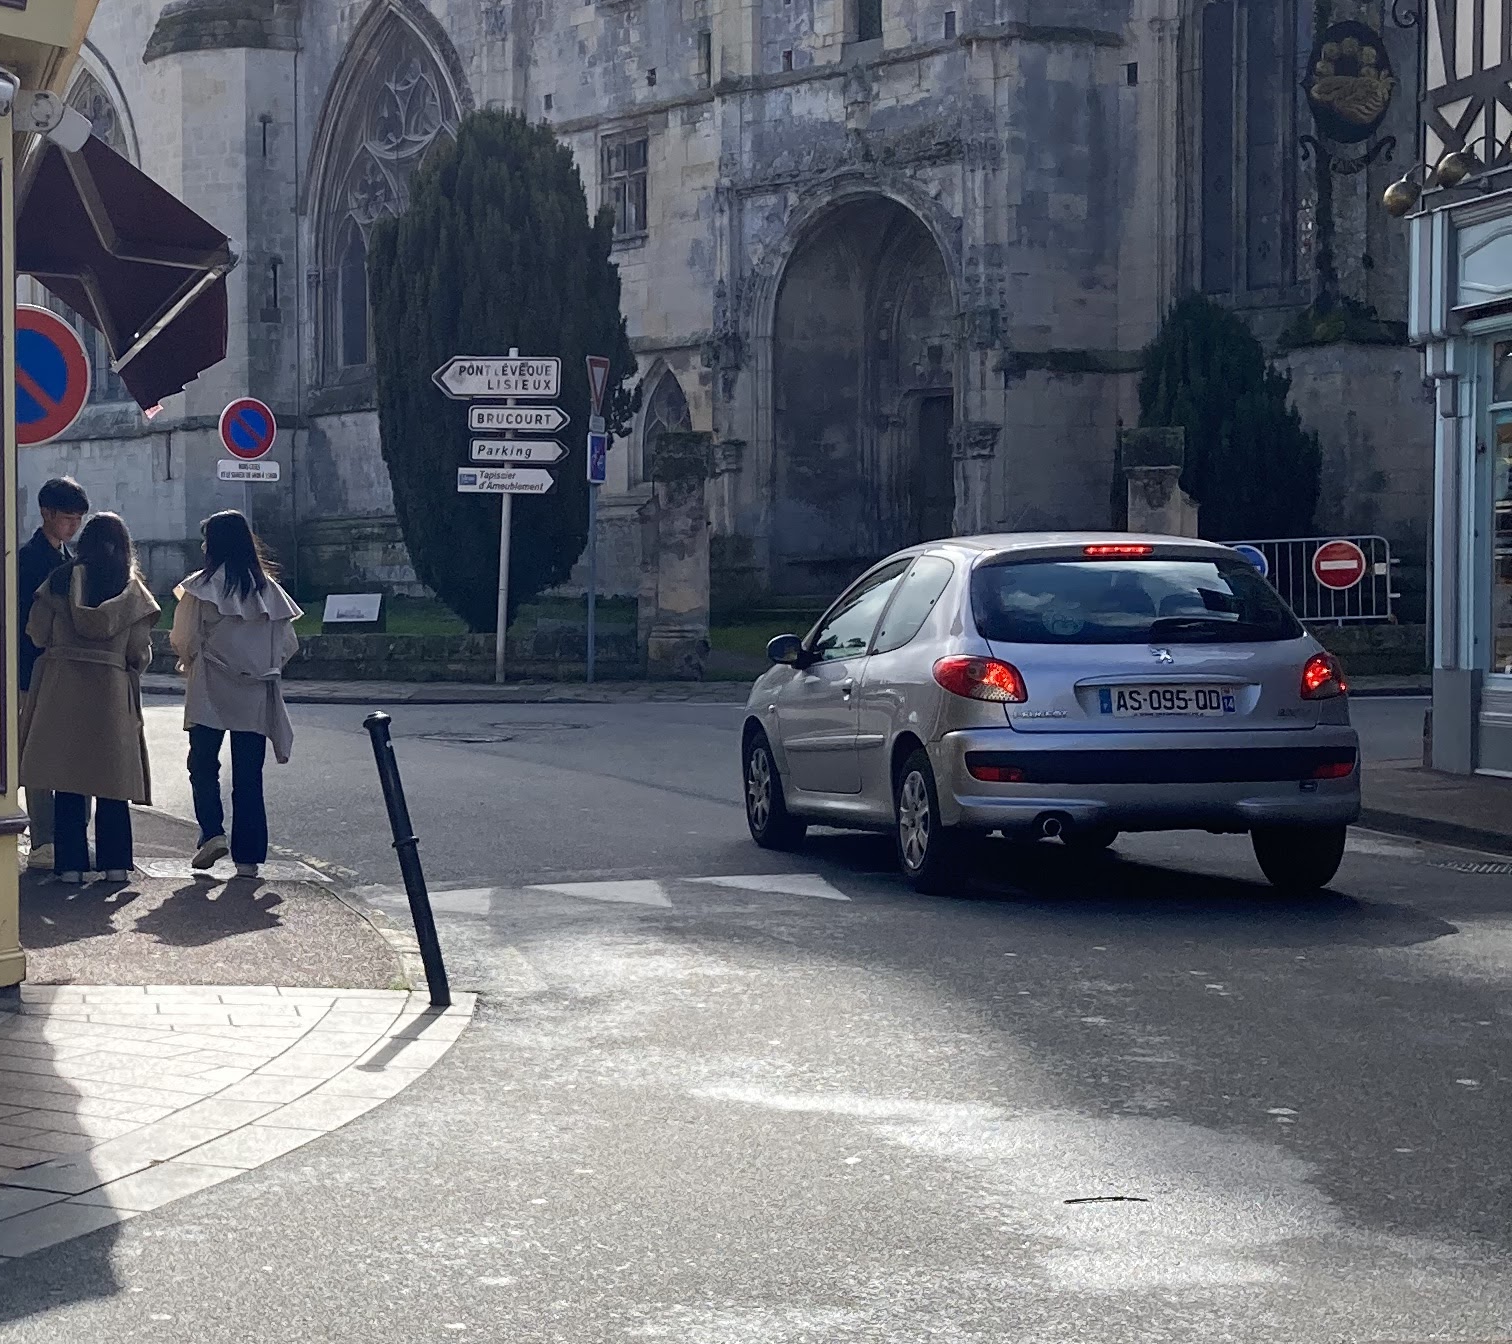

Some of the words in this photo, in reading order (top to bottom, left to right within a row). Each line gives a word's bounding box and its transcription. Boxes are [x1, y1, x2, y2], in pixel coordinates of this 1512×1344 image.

[487, 379, 552, 391] LISIEUX
[476, 413, 552, 425] BRUCOURT
[477, 444, 533, 459] Parking
